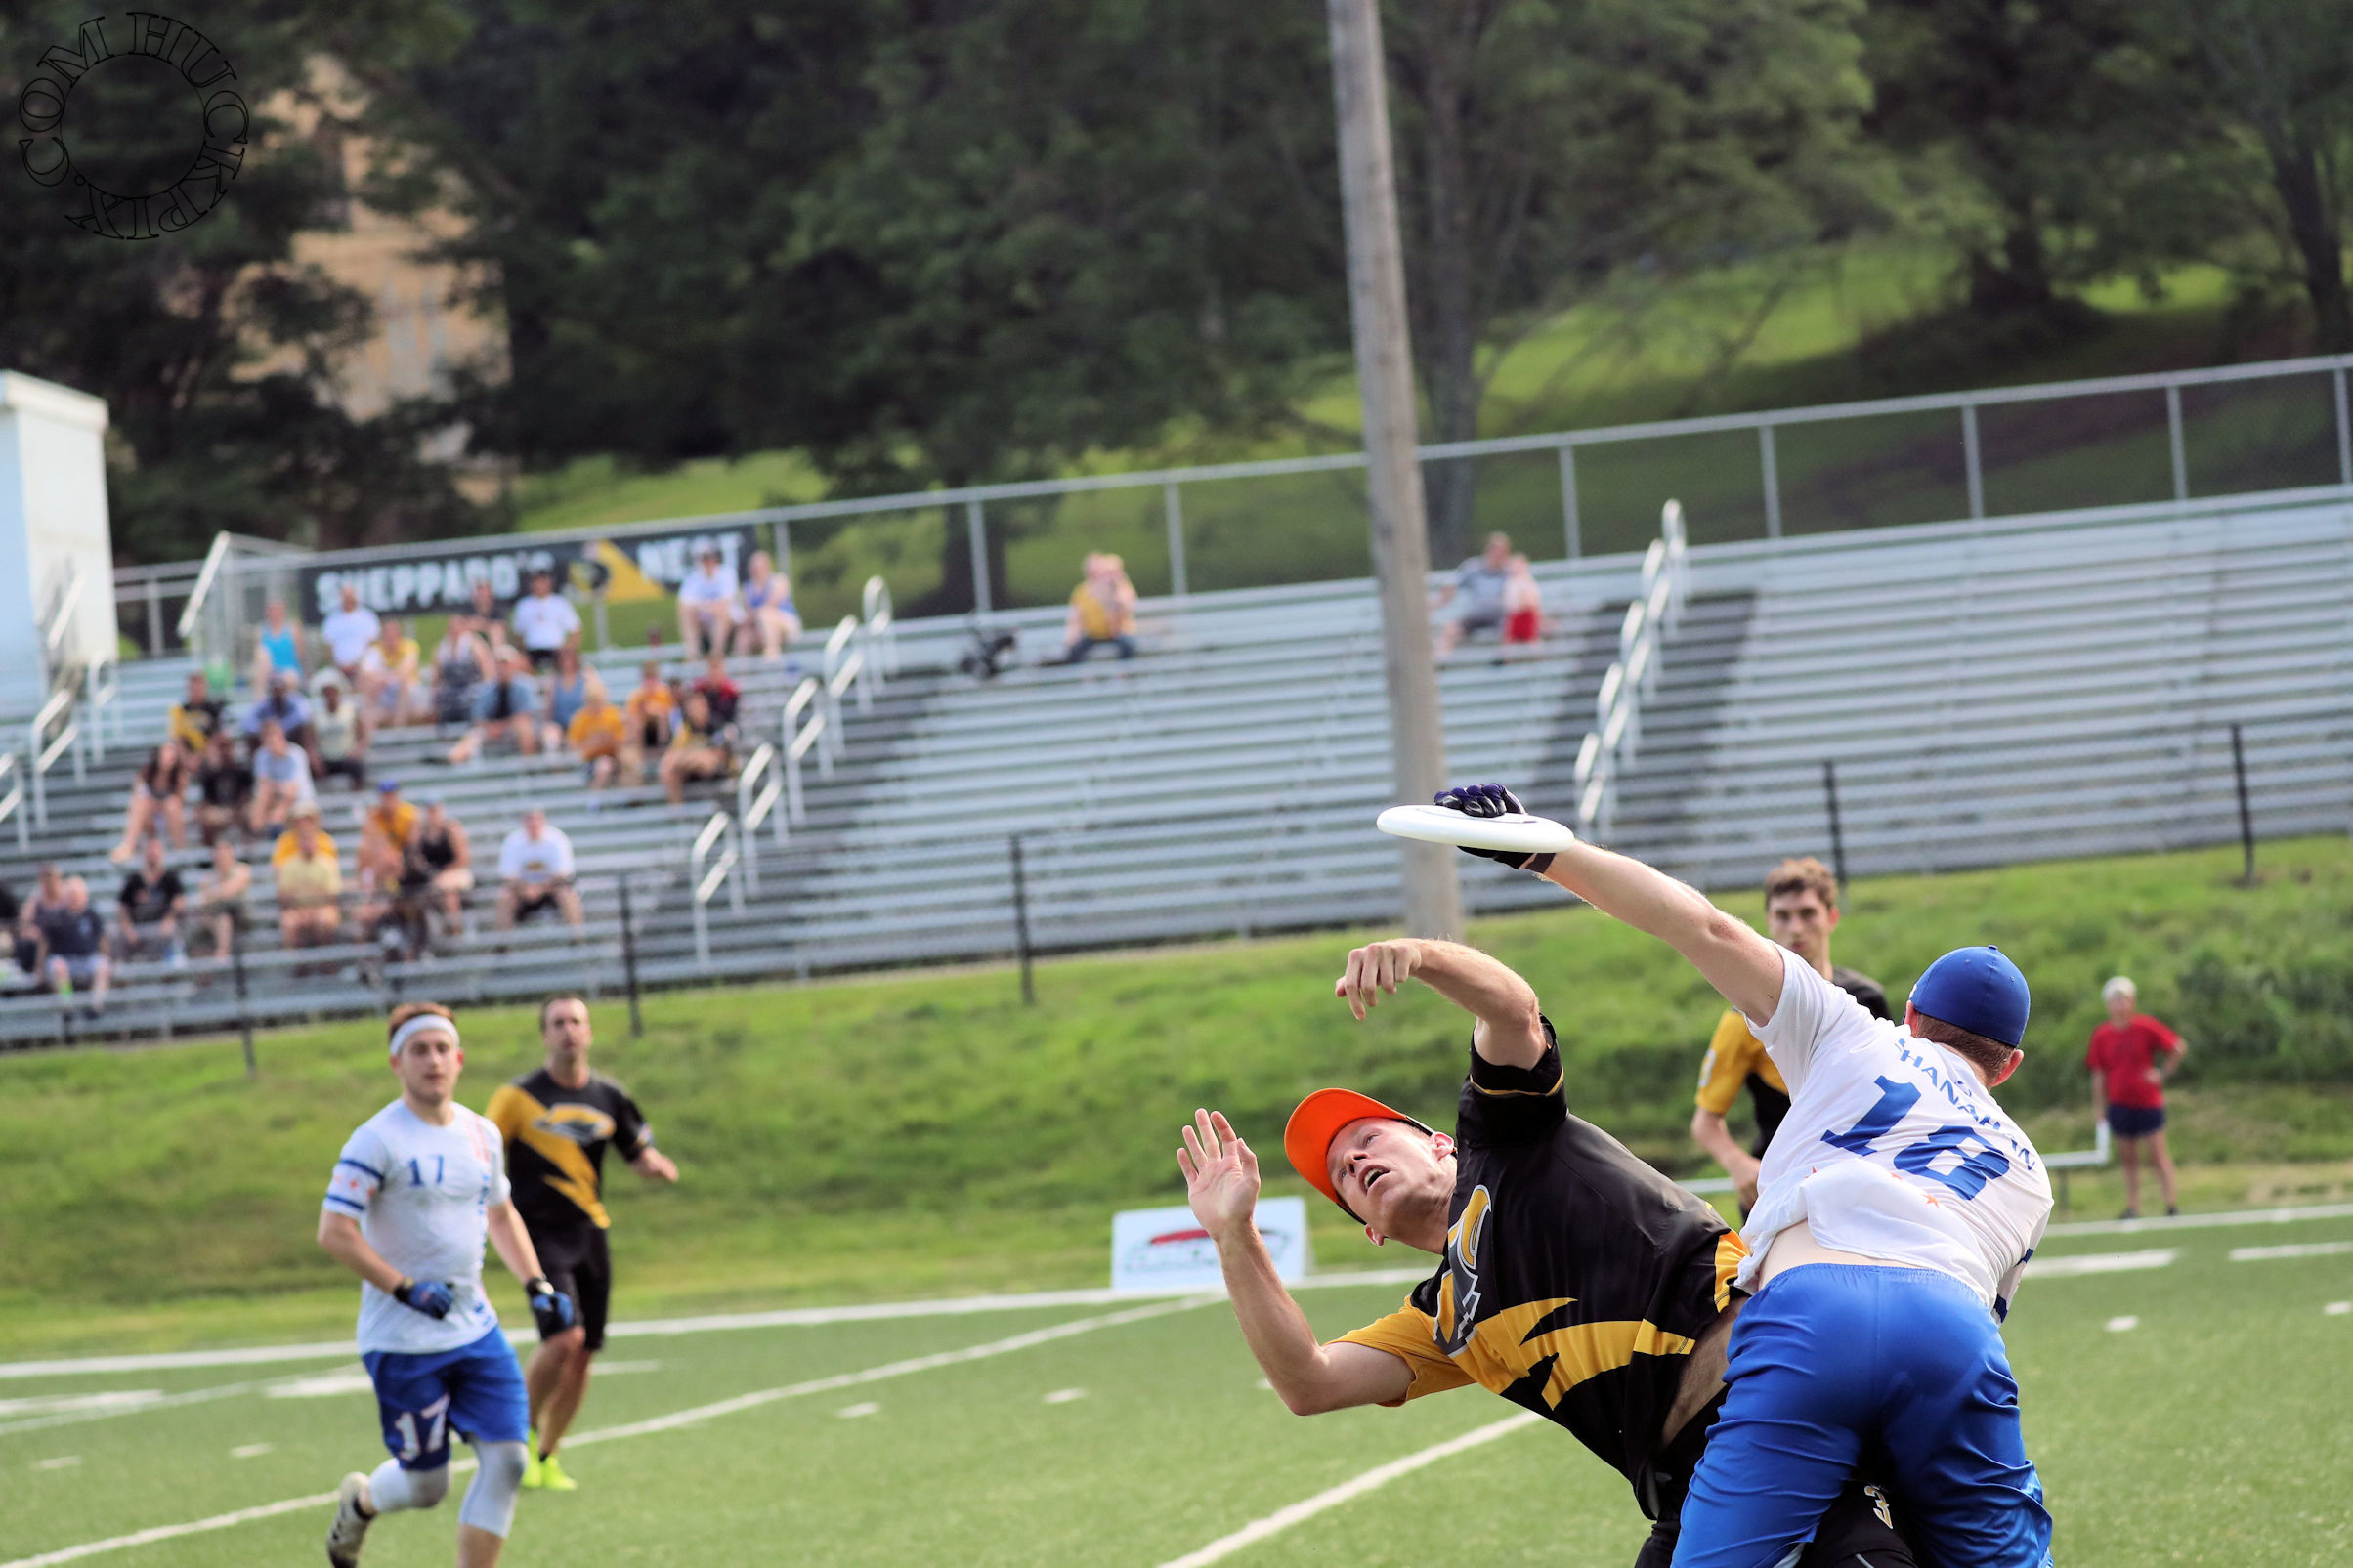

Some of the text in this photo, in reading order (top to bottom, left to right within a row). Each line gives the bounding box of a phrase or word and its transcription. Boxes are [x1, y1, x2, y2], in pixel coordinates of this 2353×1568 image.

[636, 531, 744, 583] NET
[1820, 1075, 2010, 1201] 18
[407, 1154, 445, 1188] 17
[394, 1392, 451, 1462] 17
